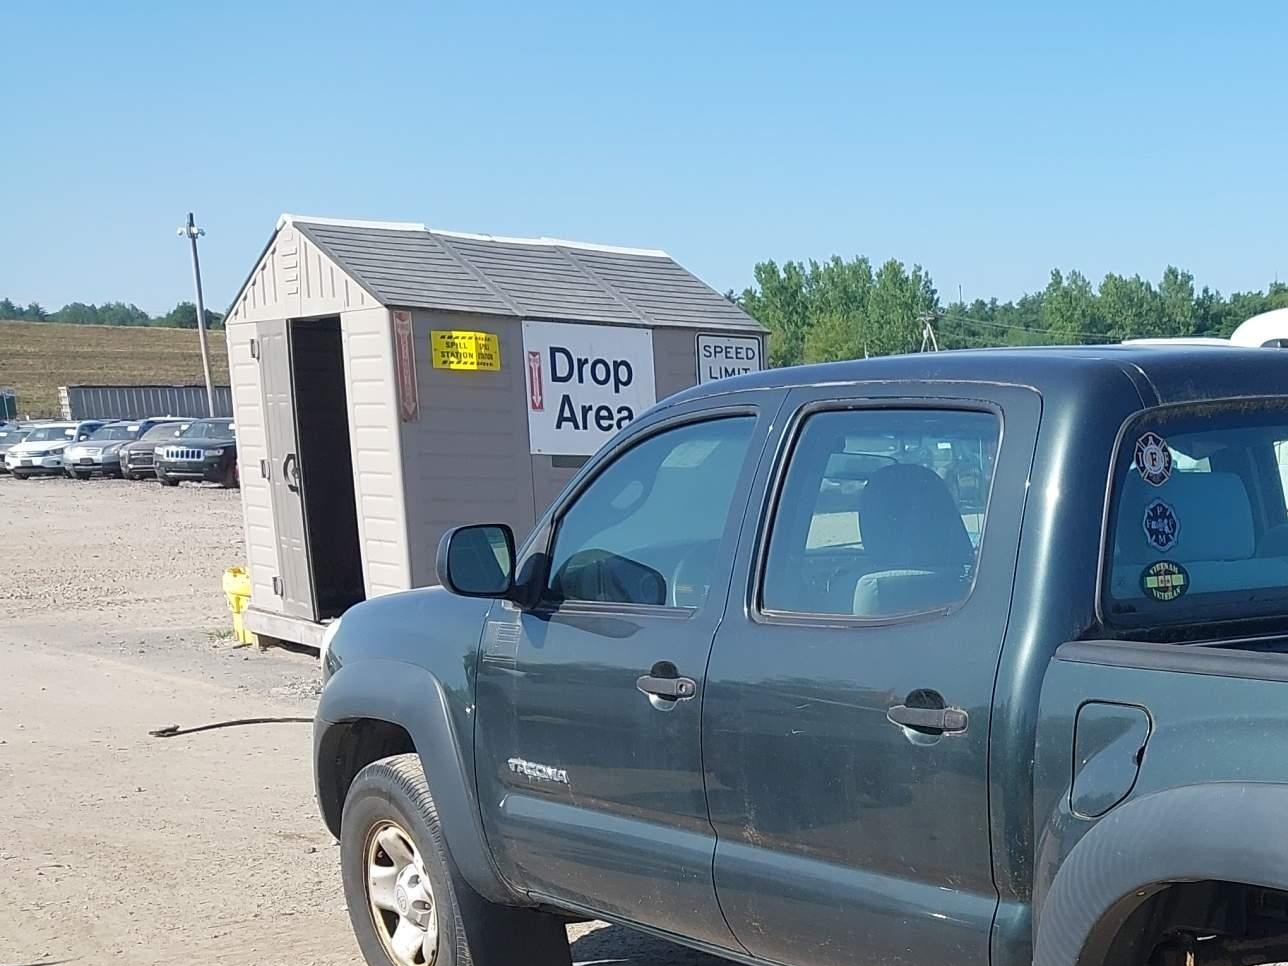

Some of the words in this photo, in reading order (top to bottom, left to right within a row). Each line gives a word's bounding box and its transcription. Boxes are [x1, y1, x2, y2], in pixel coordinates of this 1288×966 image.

[440, 351, 474, 362] STATION
[445, 341, 468, 350] SPILL
[703, 344, 756, 361] SPEED
[549, 346, 633, 394] Drop
[555, 394, 635, 432] Area
[507, 757, 568, 784] TACOMA
